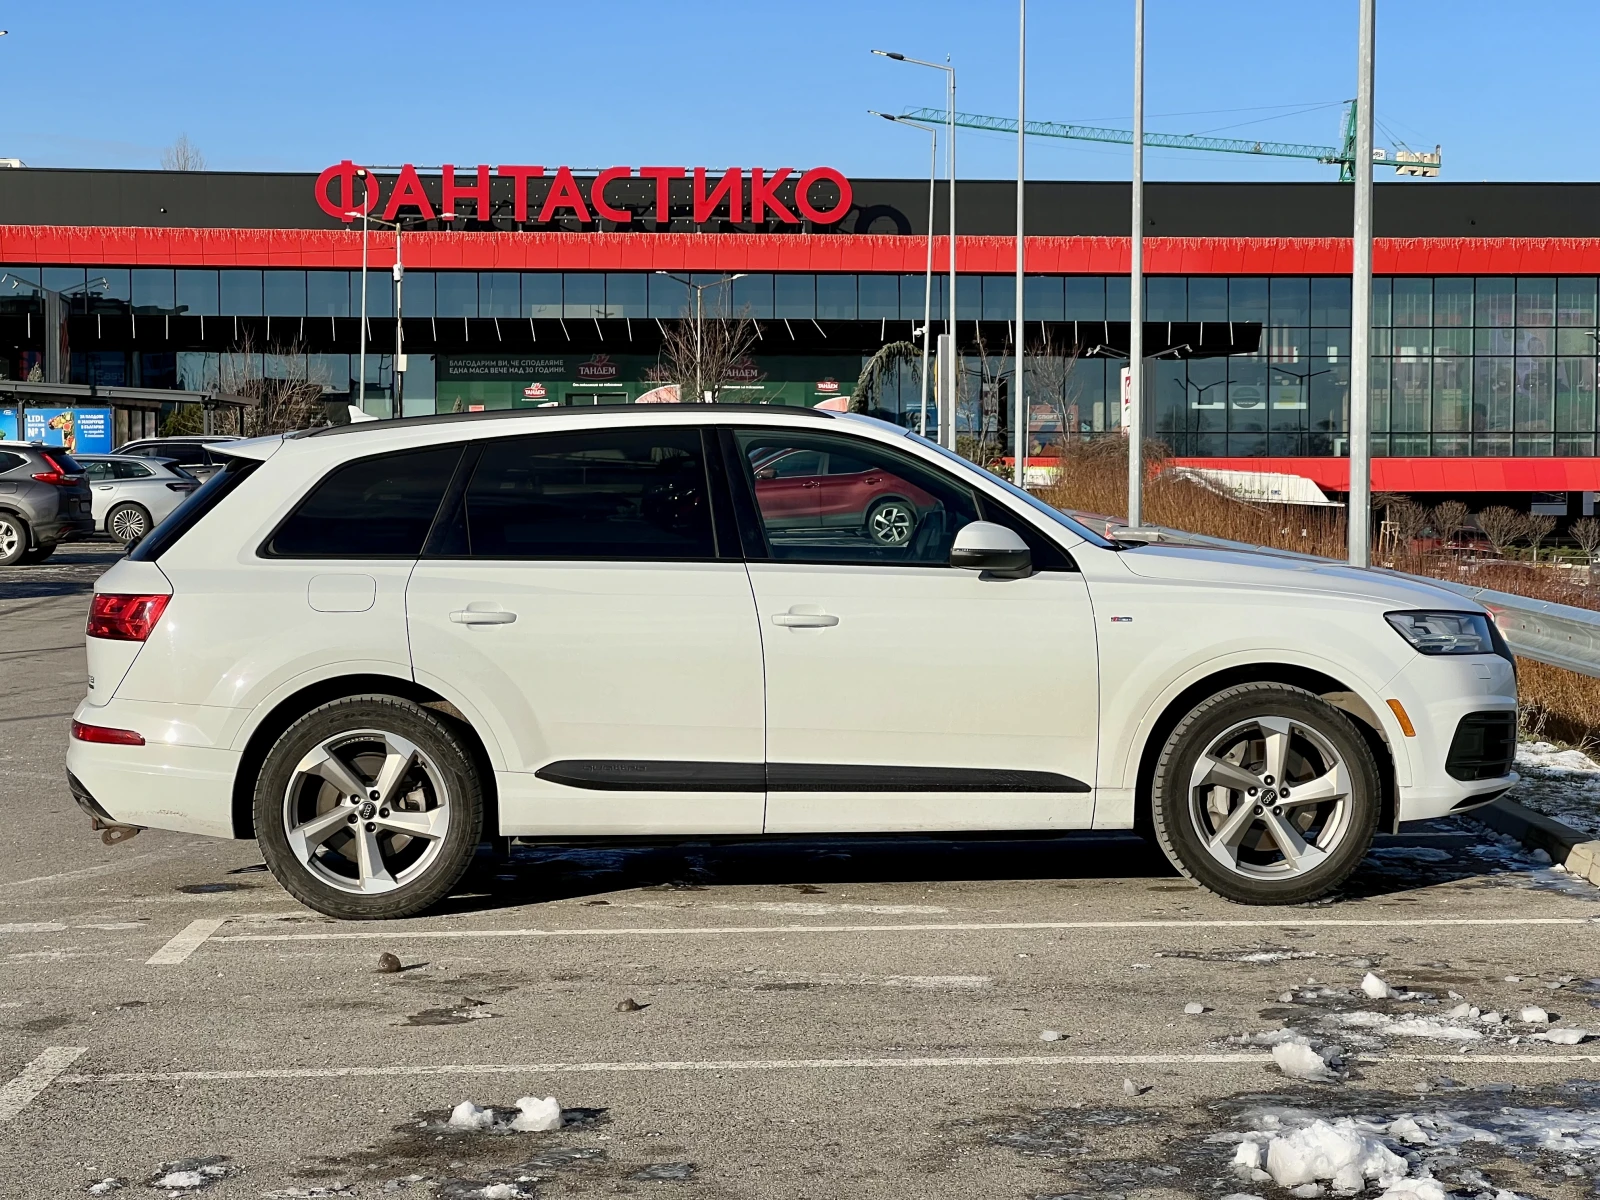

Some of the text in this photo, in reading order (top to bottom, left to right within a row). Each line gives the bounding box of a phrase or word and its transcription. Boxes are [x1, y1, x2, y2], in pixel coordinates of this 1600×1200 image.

[315, 160, 852, 224] ФАНТАСТИКО
[520, 359, 564, 367] СПОДЕЛЯМЕ
[578, 366, 616, 375] ТАНДЕМ
